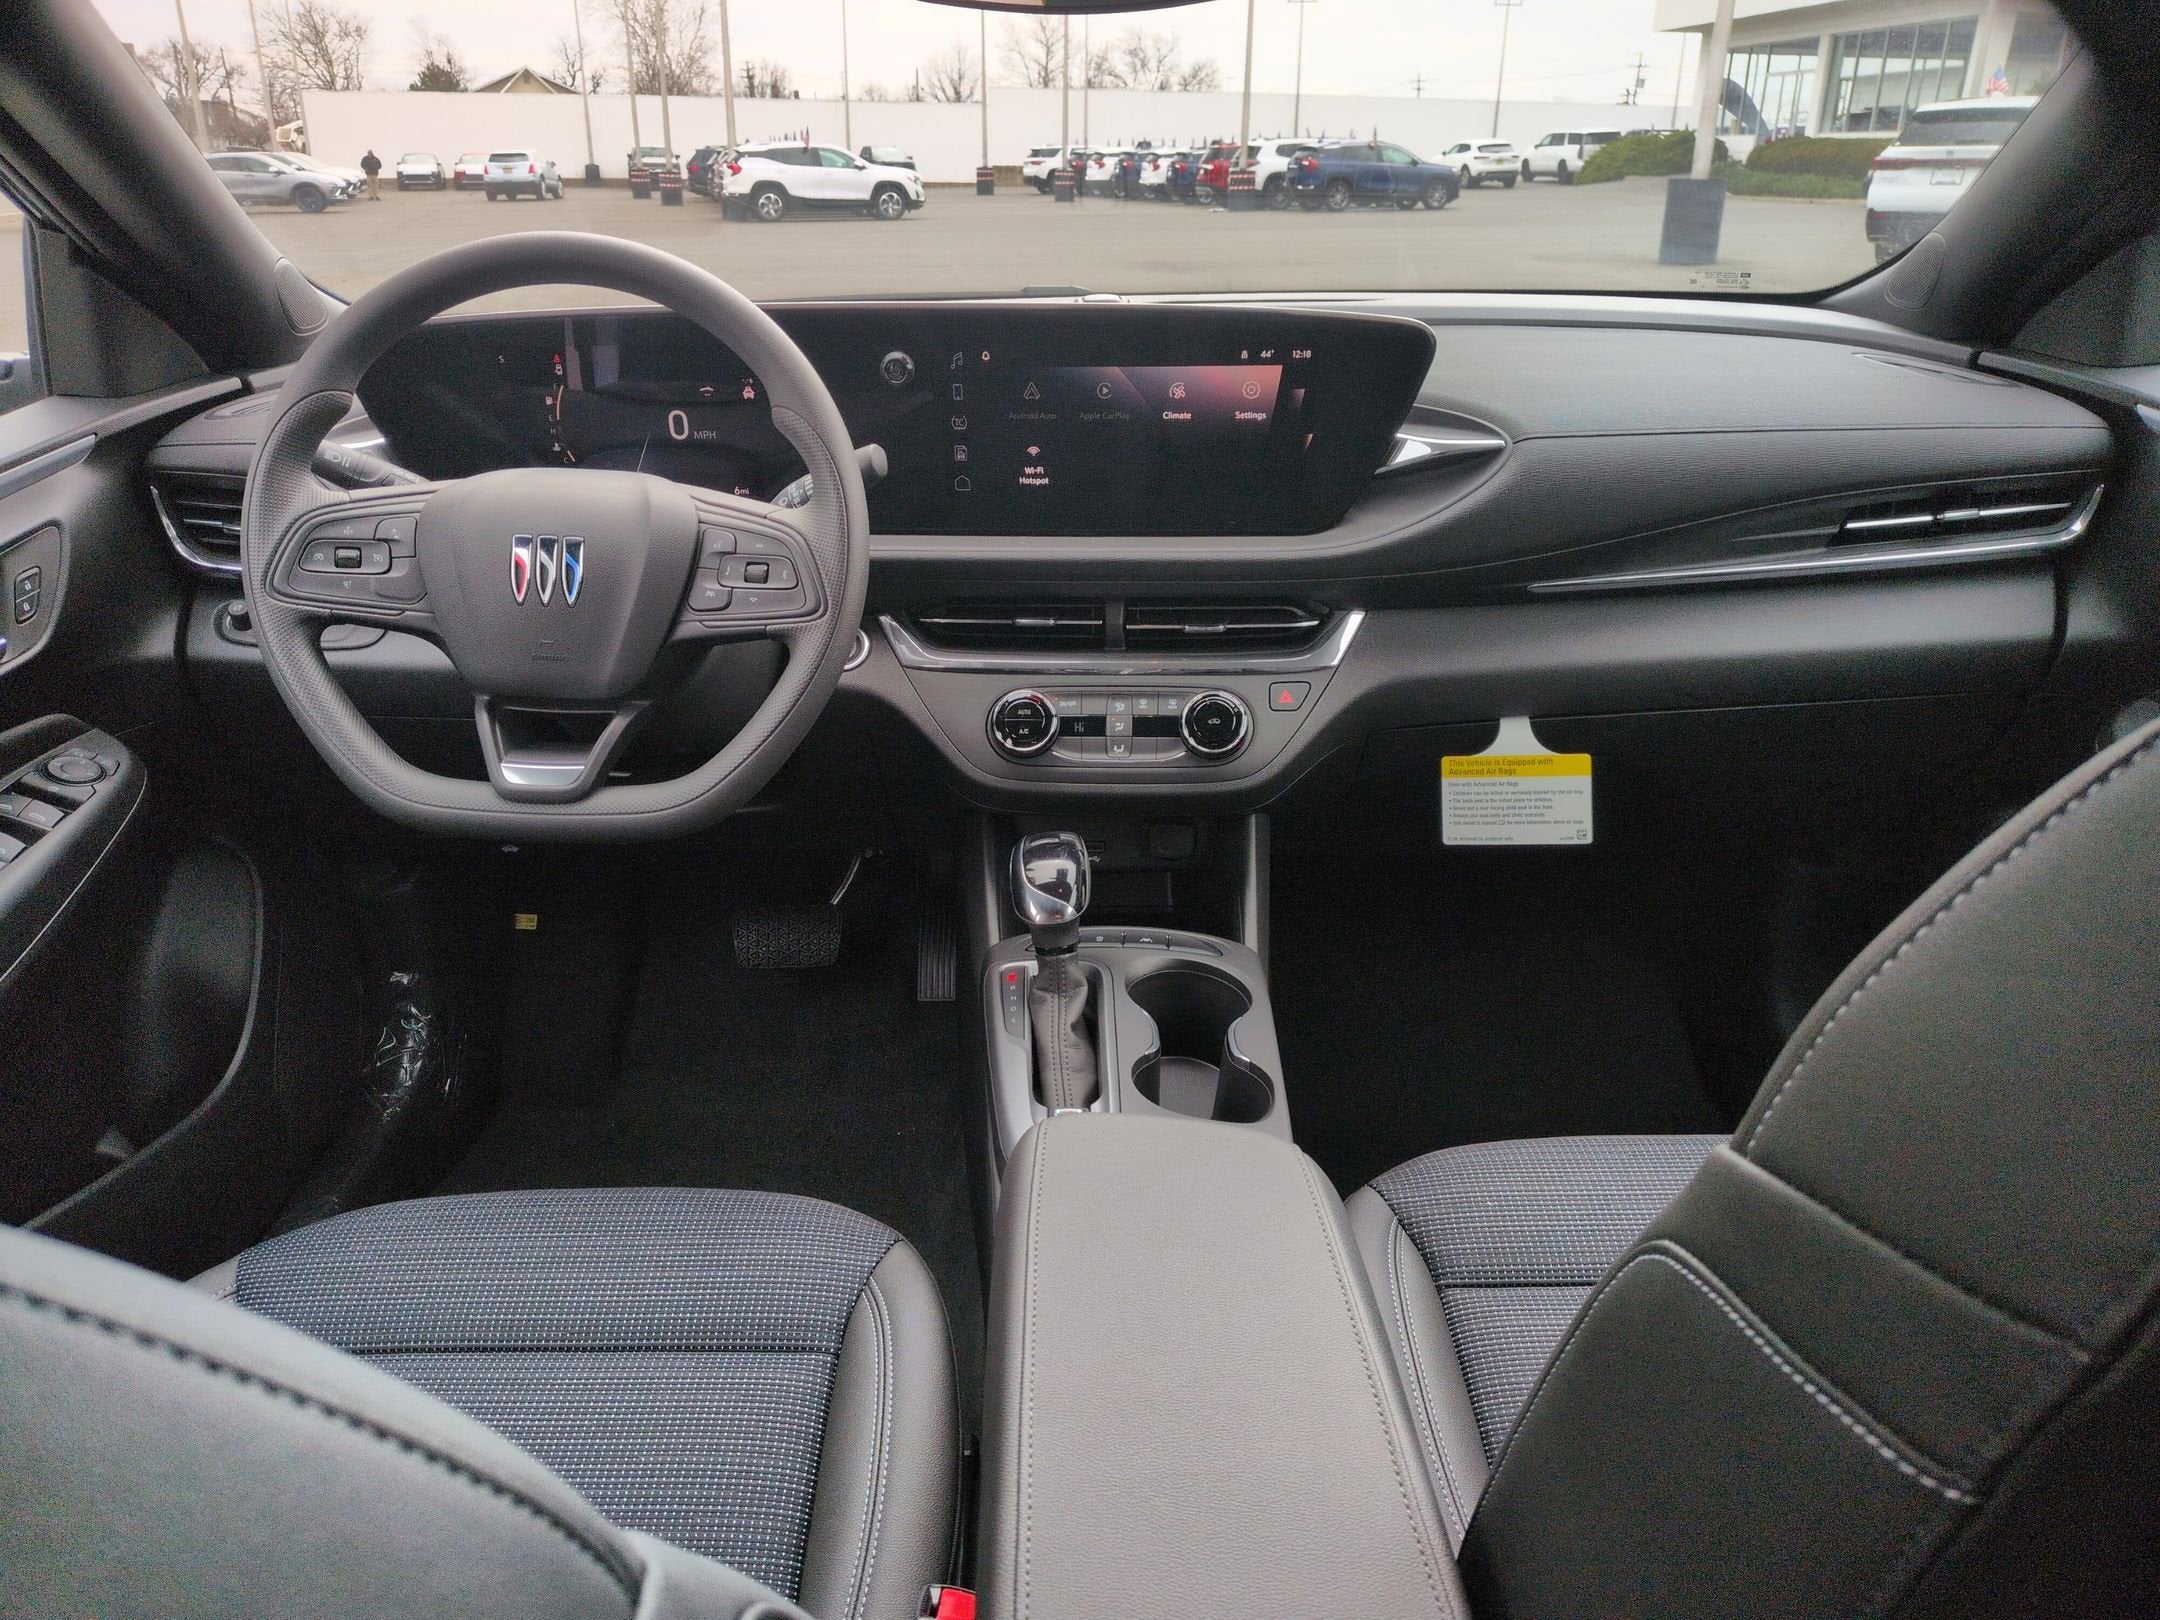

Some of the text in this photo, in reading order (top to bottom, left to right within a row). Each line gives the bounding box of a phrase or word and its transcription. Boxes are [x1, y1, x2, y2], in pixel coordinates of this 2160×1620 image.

[1292, 350, 1312, 359] 12:18
[1009, 411, 1057, 419] Android Auto
[1080, 411, 1130, 421] Apple CarPlay
[1162, 411, 1192, 420] Climate
[1235, 411, 1267, 421] Settings
[668, 409, 717, 440] 0 MPH
[1024, 466, 1044, 475] Wi-Fi
[1019, 476, 1049, 486] Hotspot
[1074, 721, 1085, 733] Hi
[1449, 759, 1465, 767] This
[1467, 759, 1492, 767] Vehicle
[1502, 758, 1536, 768] Equipped
[1537, 757, 1554, 766] with
[1449, 767, 1517, 777] Advanced Air Bags
